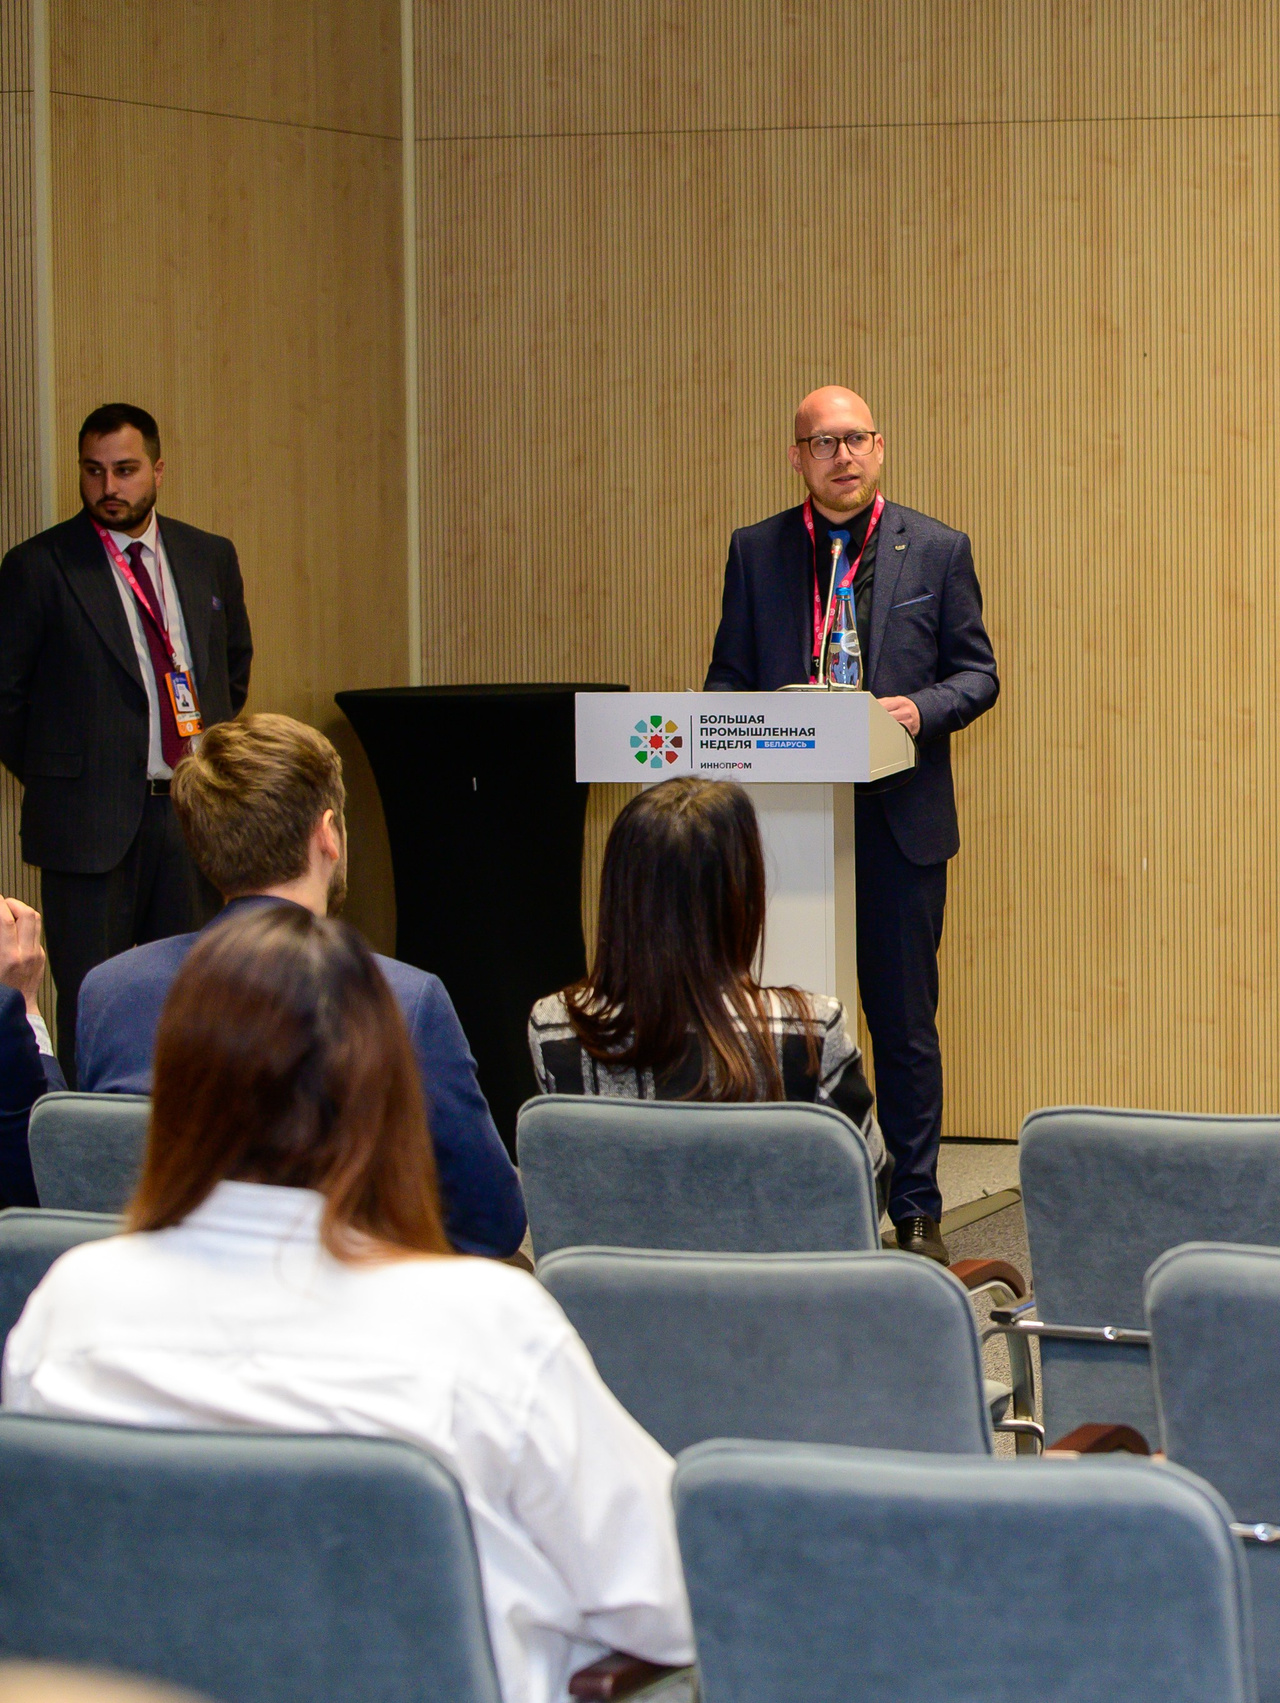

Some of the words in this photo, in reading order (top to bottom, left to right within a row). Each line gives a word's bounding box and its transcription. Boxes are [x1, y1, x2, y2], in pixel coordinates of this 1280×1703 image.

[699, 714, 765, 725] БОЛЬШАЯ
[699, 727, 816, 738] ПРОМЫШЛЕННАЯ
[699, 739, 752, 751] НЕДЕЛЯ
[764, 740, 807, 749] БЕЛАРУСЬ
[700, 762, 752, 770] ИННОПРОМ
